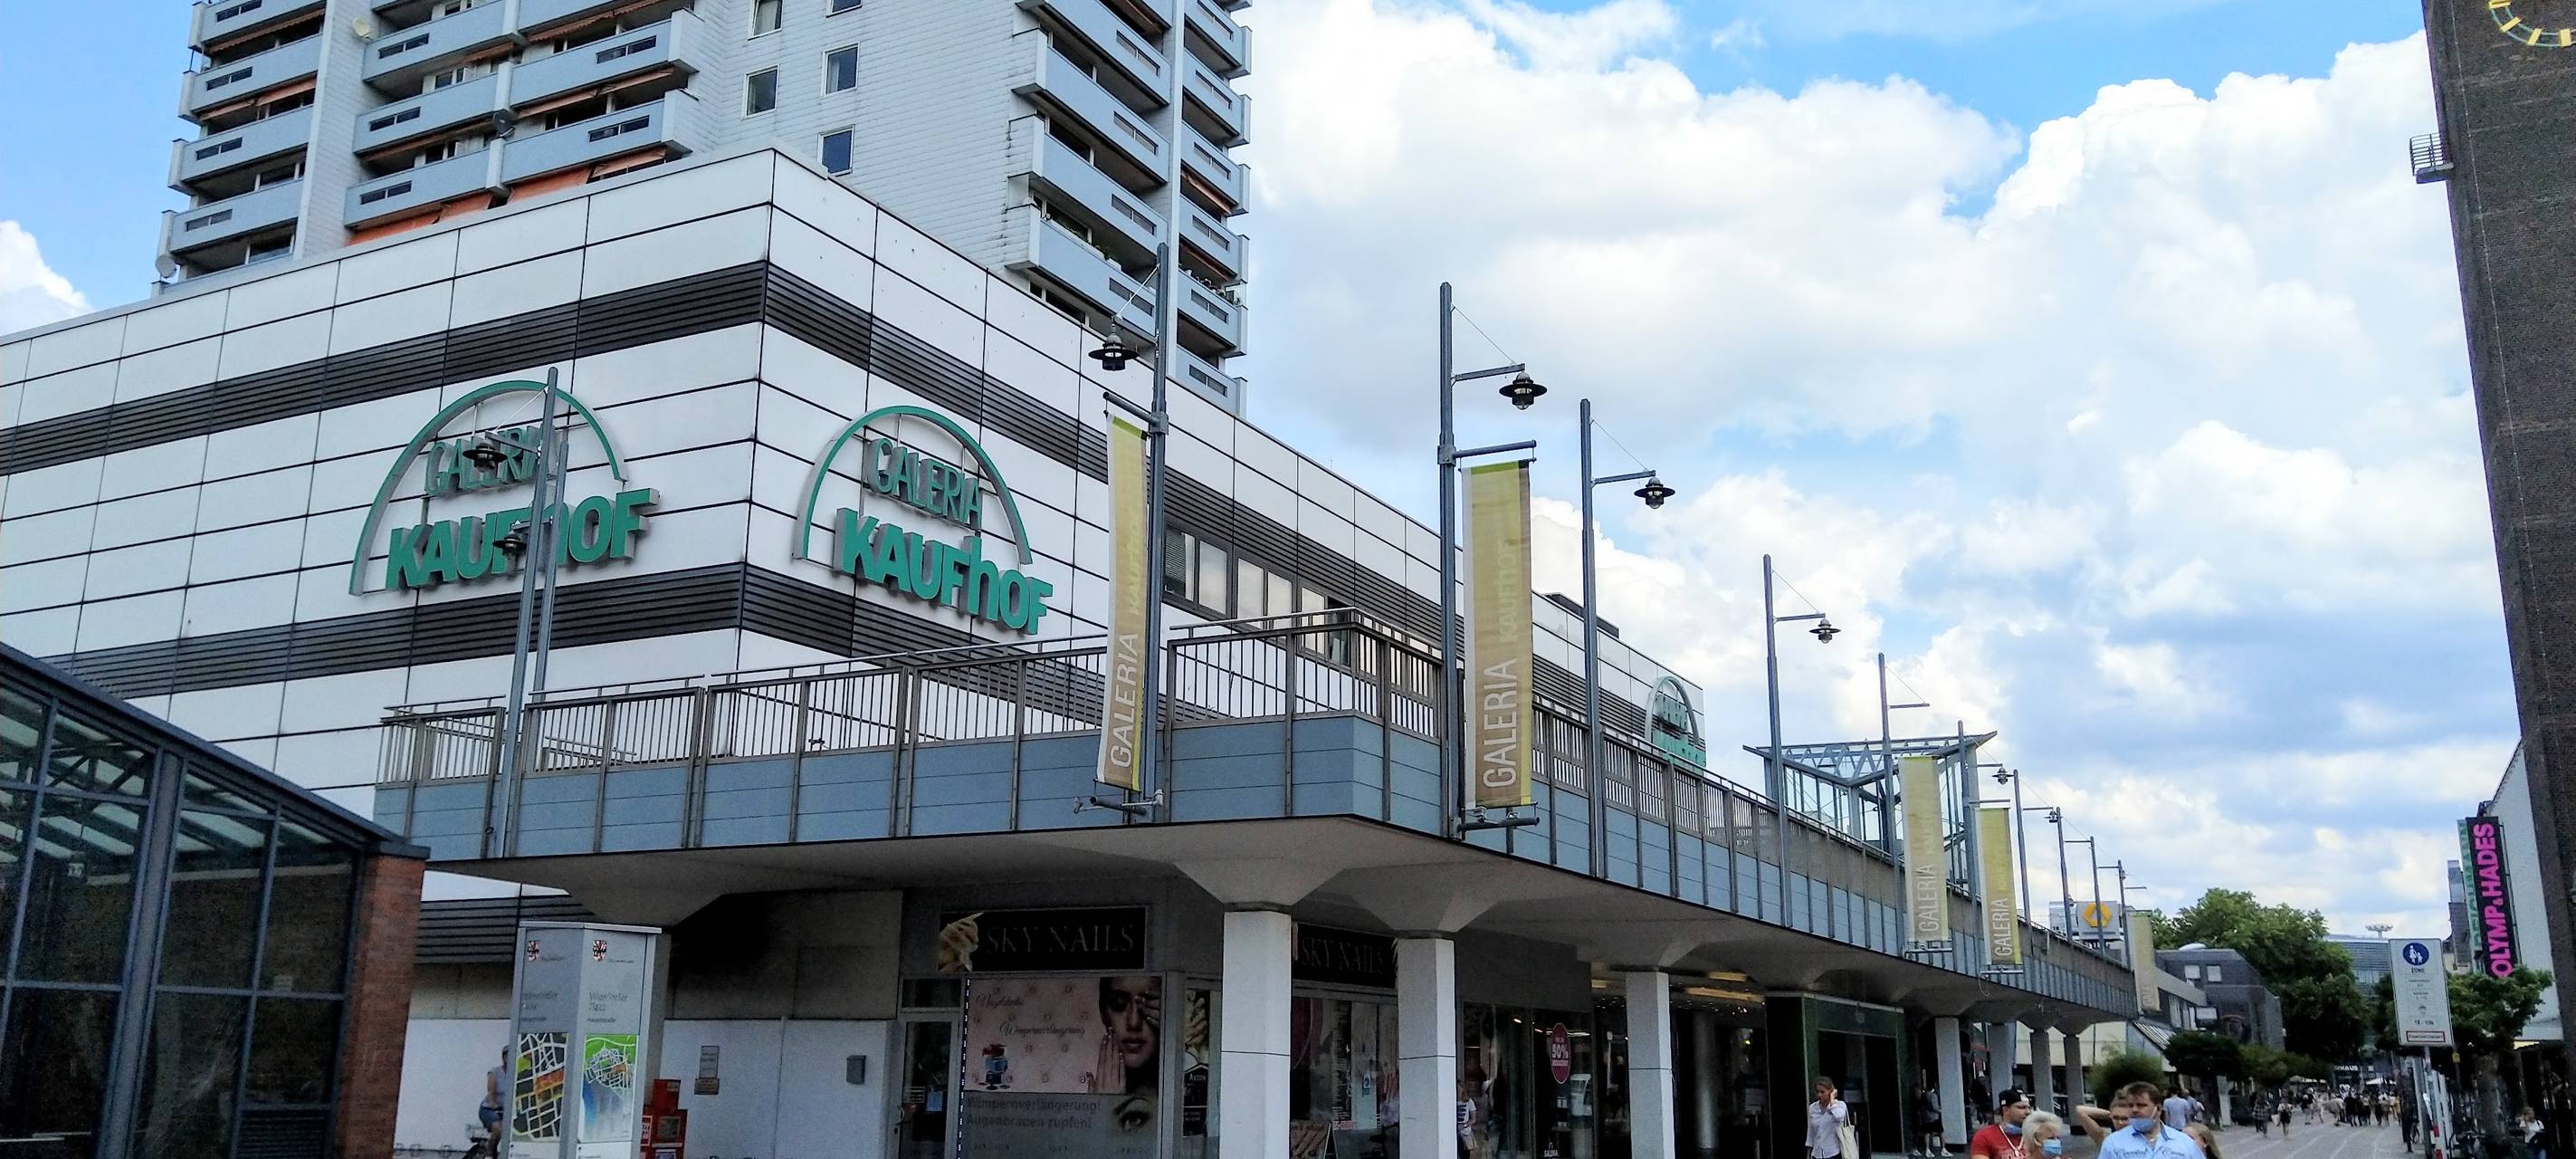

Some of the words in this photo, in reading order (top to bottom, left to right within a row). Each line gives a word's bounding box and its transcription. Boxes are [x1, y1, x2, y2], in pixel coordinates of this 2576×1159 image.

[424, 423, 558, 496] GALRI
[863, 438, 983, 530] GALERIA
[1110, 633, 1139, 769] GALERIA
[1482, 657, 1518, 789] GALERIA
[1918, 862, 1941, 933] GALERIA
[1994, 897, 2013, 957] GALERIA
[986, 925, 1039, 953] SKY
[1049, 924, 1134, 953] NAILS
[1302, 935, 1335, 968] SKY
[1339, 942, 1385, 976] NAILS
[1551, 1044, 1569, 1058] 50%
